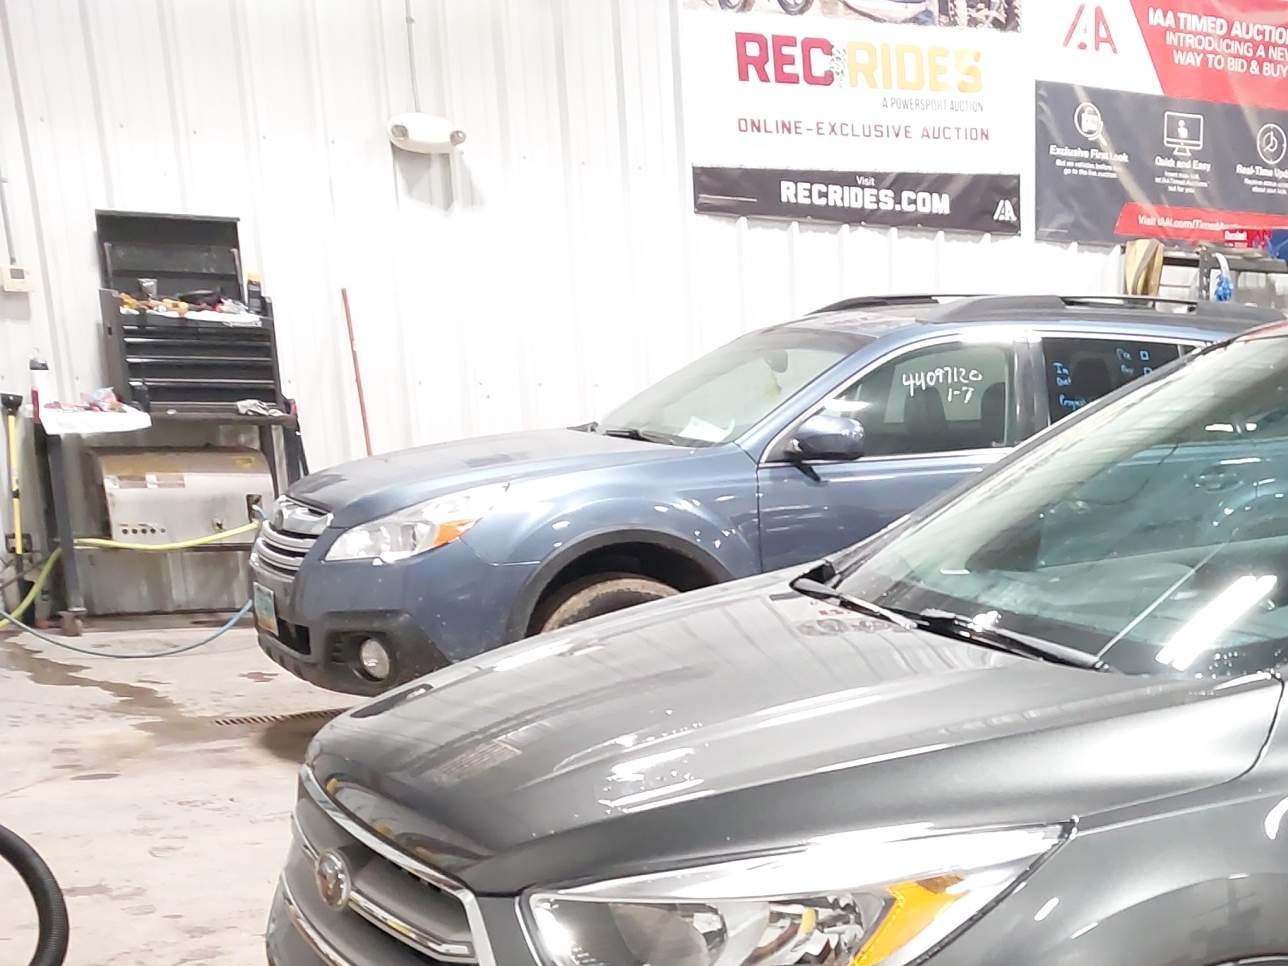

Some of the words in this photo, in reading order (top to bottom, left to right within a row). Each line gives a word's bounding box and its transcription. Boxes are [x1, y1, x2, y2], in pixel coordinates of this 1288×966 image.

[1148, 7, 1176, 29] IAA
[1177, 12, 1228, 36] TIMED
[1166, 31, 1253, 57] INTRODUCING
[1256, 44, 1265, 58] A
[1173, 50, 1203, 66] WAY
[1206, 53, 1225, 68] TO
[1227, 56, 1247, 73] BID
[1249, 60, 1260, 75] &
[1263, 62, 1288, 78] BUY
[882, 97, 889, 109] A
[949, 100, 984, 113] AUCTION
[738, 118, 913, 139] ONLINE-EXCLUSIVE
[920, 126, 990, 141] AUCTION
[856, 176, 876, 186] Visit
[780, 181, 950, 214] RECRIDES.COM
[903, 366, 983, 397] 44097120
[947, 386, 975, 404] 1-7
